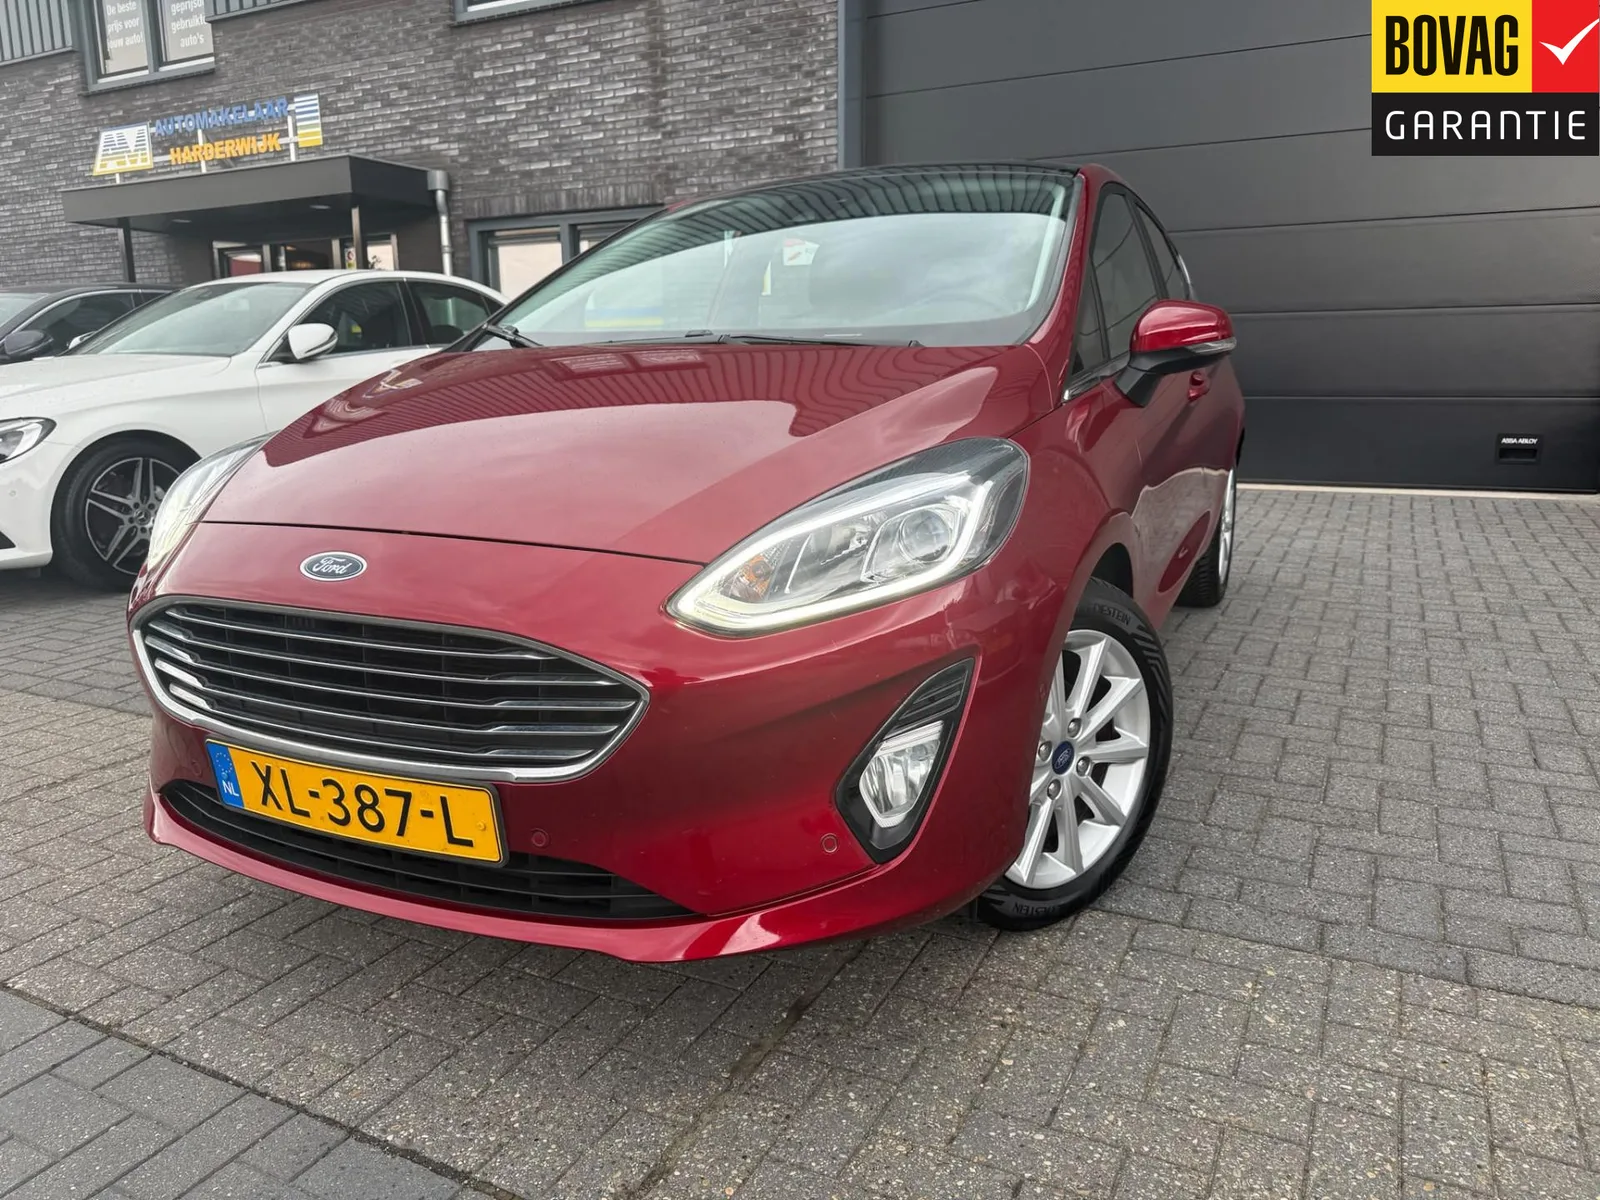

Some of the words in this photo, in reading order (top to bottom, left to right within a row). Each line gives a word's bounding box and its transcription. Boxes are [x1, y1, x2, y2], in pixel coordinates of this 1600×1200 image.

[106, 4, 116, 16] De
[117, 0, 137, 13] beste
[171, 0, 204, 16] geprijsd
[107, 20, 123, 35] prijs
[124, 17, 140, 29] voor
[125, 31, 144, 46] auto!
[180, 32, 205, 48] auto's
[154, 96, 289, 137] AUTOMAKELAAR
[169, 132, 282, 166] HARDERWIJK
[312, 556, 353, 575] Ford
[221, 779, 240, 797] NL
[250, 760, 475, 849] XL-387-L
